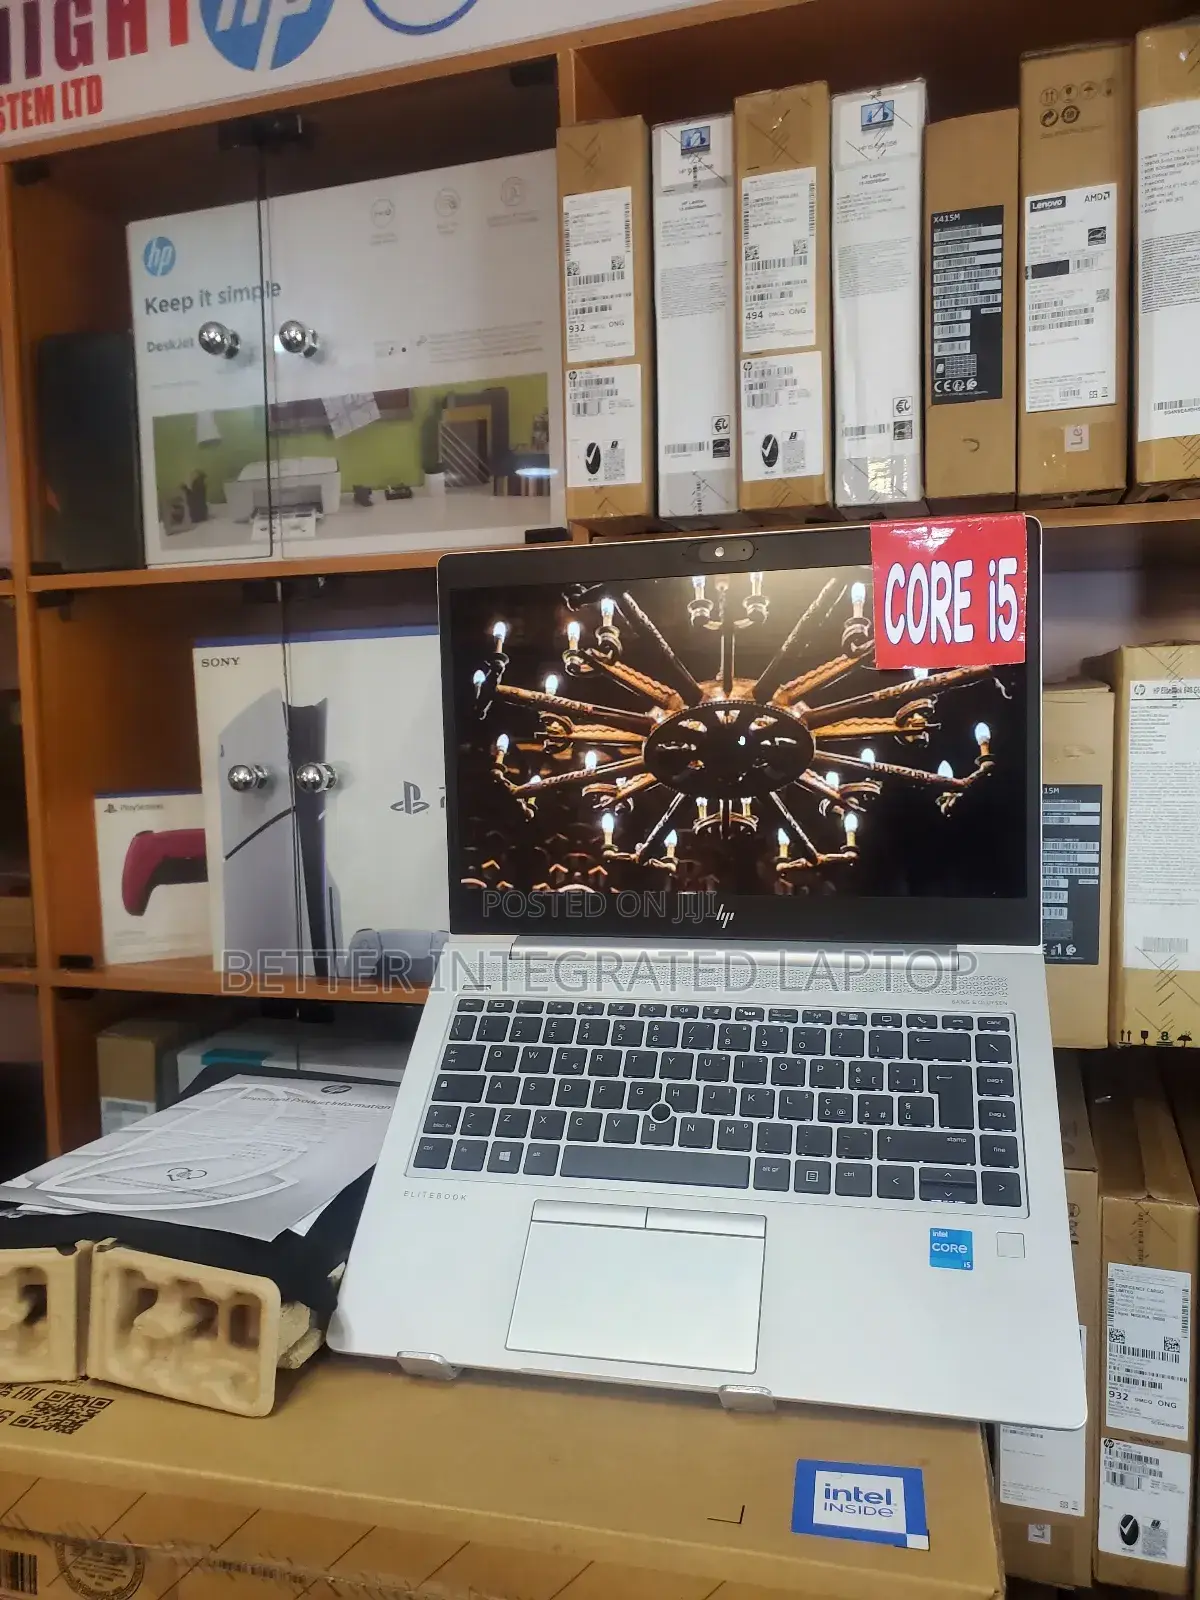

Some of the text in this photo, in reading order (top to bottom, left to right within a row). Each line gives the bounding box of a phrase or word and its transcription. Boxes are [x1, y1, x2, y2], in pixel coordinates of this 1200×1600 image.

[61, 74, 103, 120] LTD
[1032, 193, 1103, 210] Lenovo AMD
[933, 213, 961, 223] X415M
[147, 237, 175, 276] hp
[144, 280, 281, 315] Keep it simple
[745, 310, 763, 320] 494
[788, 306, 807, 315] ONG
[568, 323, 586, 333] 932
[884, 557, 1018, 645] CORE i5
[201, 656, 240, 668] SONY
[291, 1097, 331, 1105] Product
[331, 1102, 392, 1110] Information
[403, 1190, 467, 1201] ELITEBOOK
[932, 1230, 948, 1238] intel
[1108, 1390, 1129, 1402] 932
[1157, 1399, 1177, 1409] ONG
[824, 1483, 892, 1506] intel
